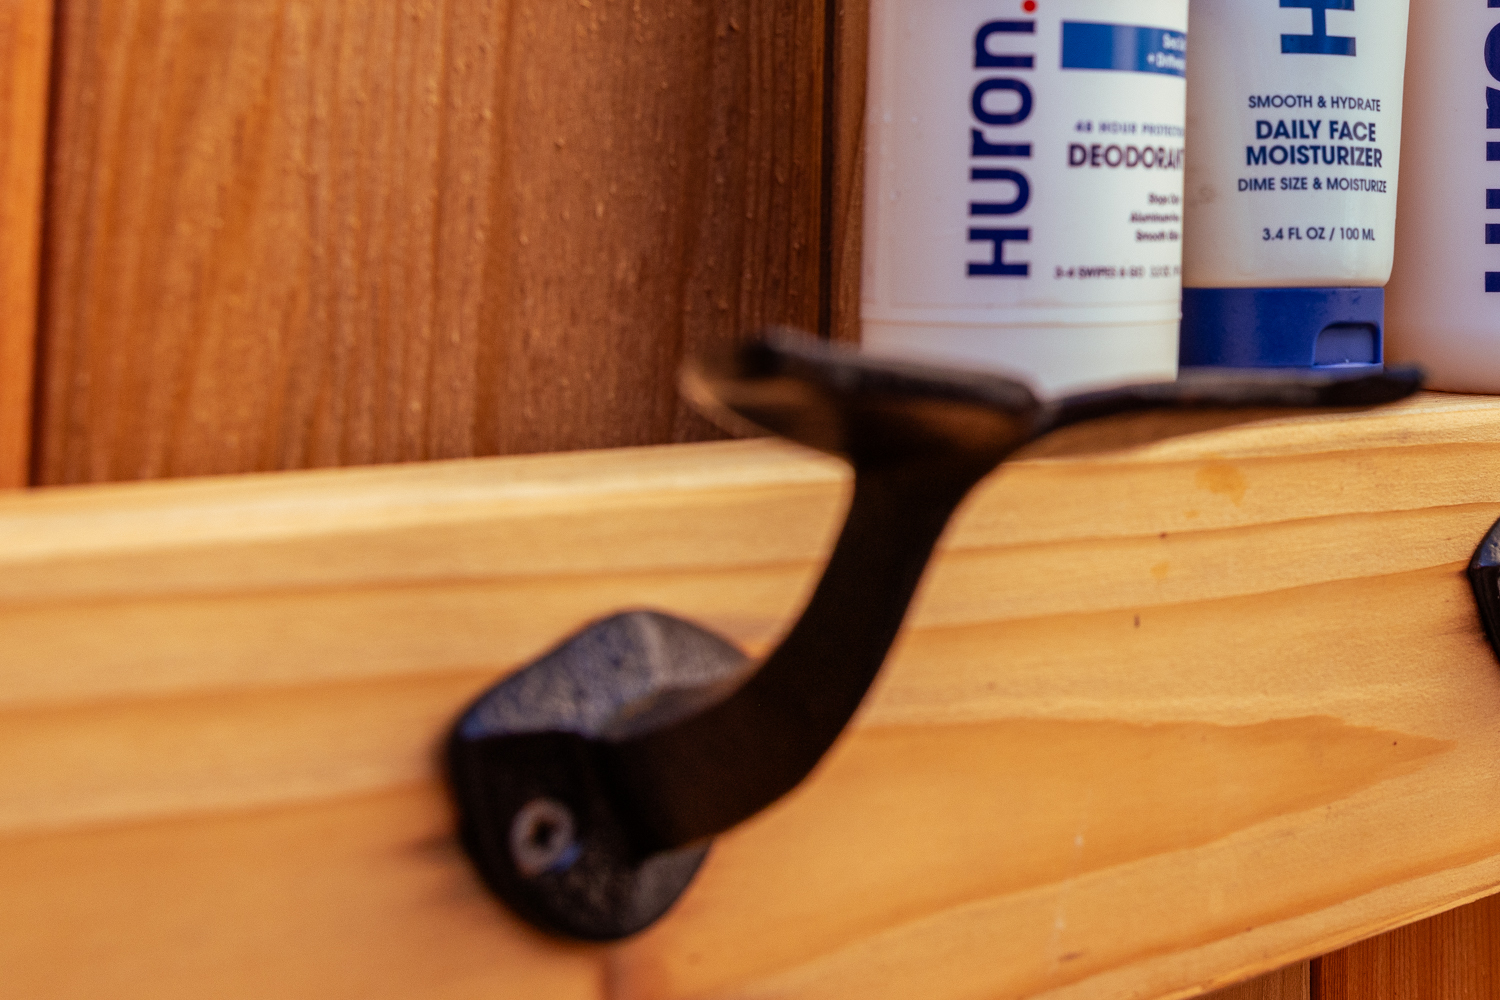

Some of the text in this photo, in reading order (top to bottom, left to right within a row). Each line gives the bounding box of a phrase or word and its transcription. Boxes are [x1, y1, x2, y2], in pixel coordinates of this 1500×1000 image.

[1248, 95, 1381, 112] SMOOTH & HYDRATE
[1255, 120, 1376, 142] DAILY FACE
[1245, 145, 1382, 168] MOISTURIZER
[1238, 177, 1387, 193] DIME SIZE & MOISTURIZE
[1262, 229, 1284, 241] 3.4
[1288, 228, 1302, 240] FL
[1306, 228, 1326, 240] OZ
[1340, 228, 1360, 241] 100
[1362, 229, 1376, 242] ML
